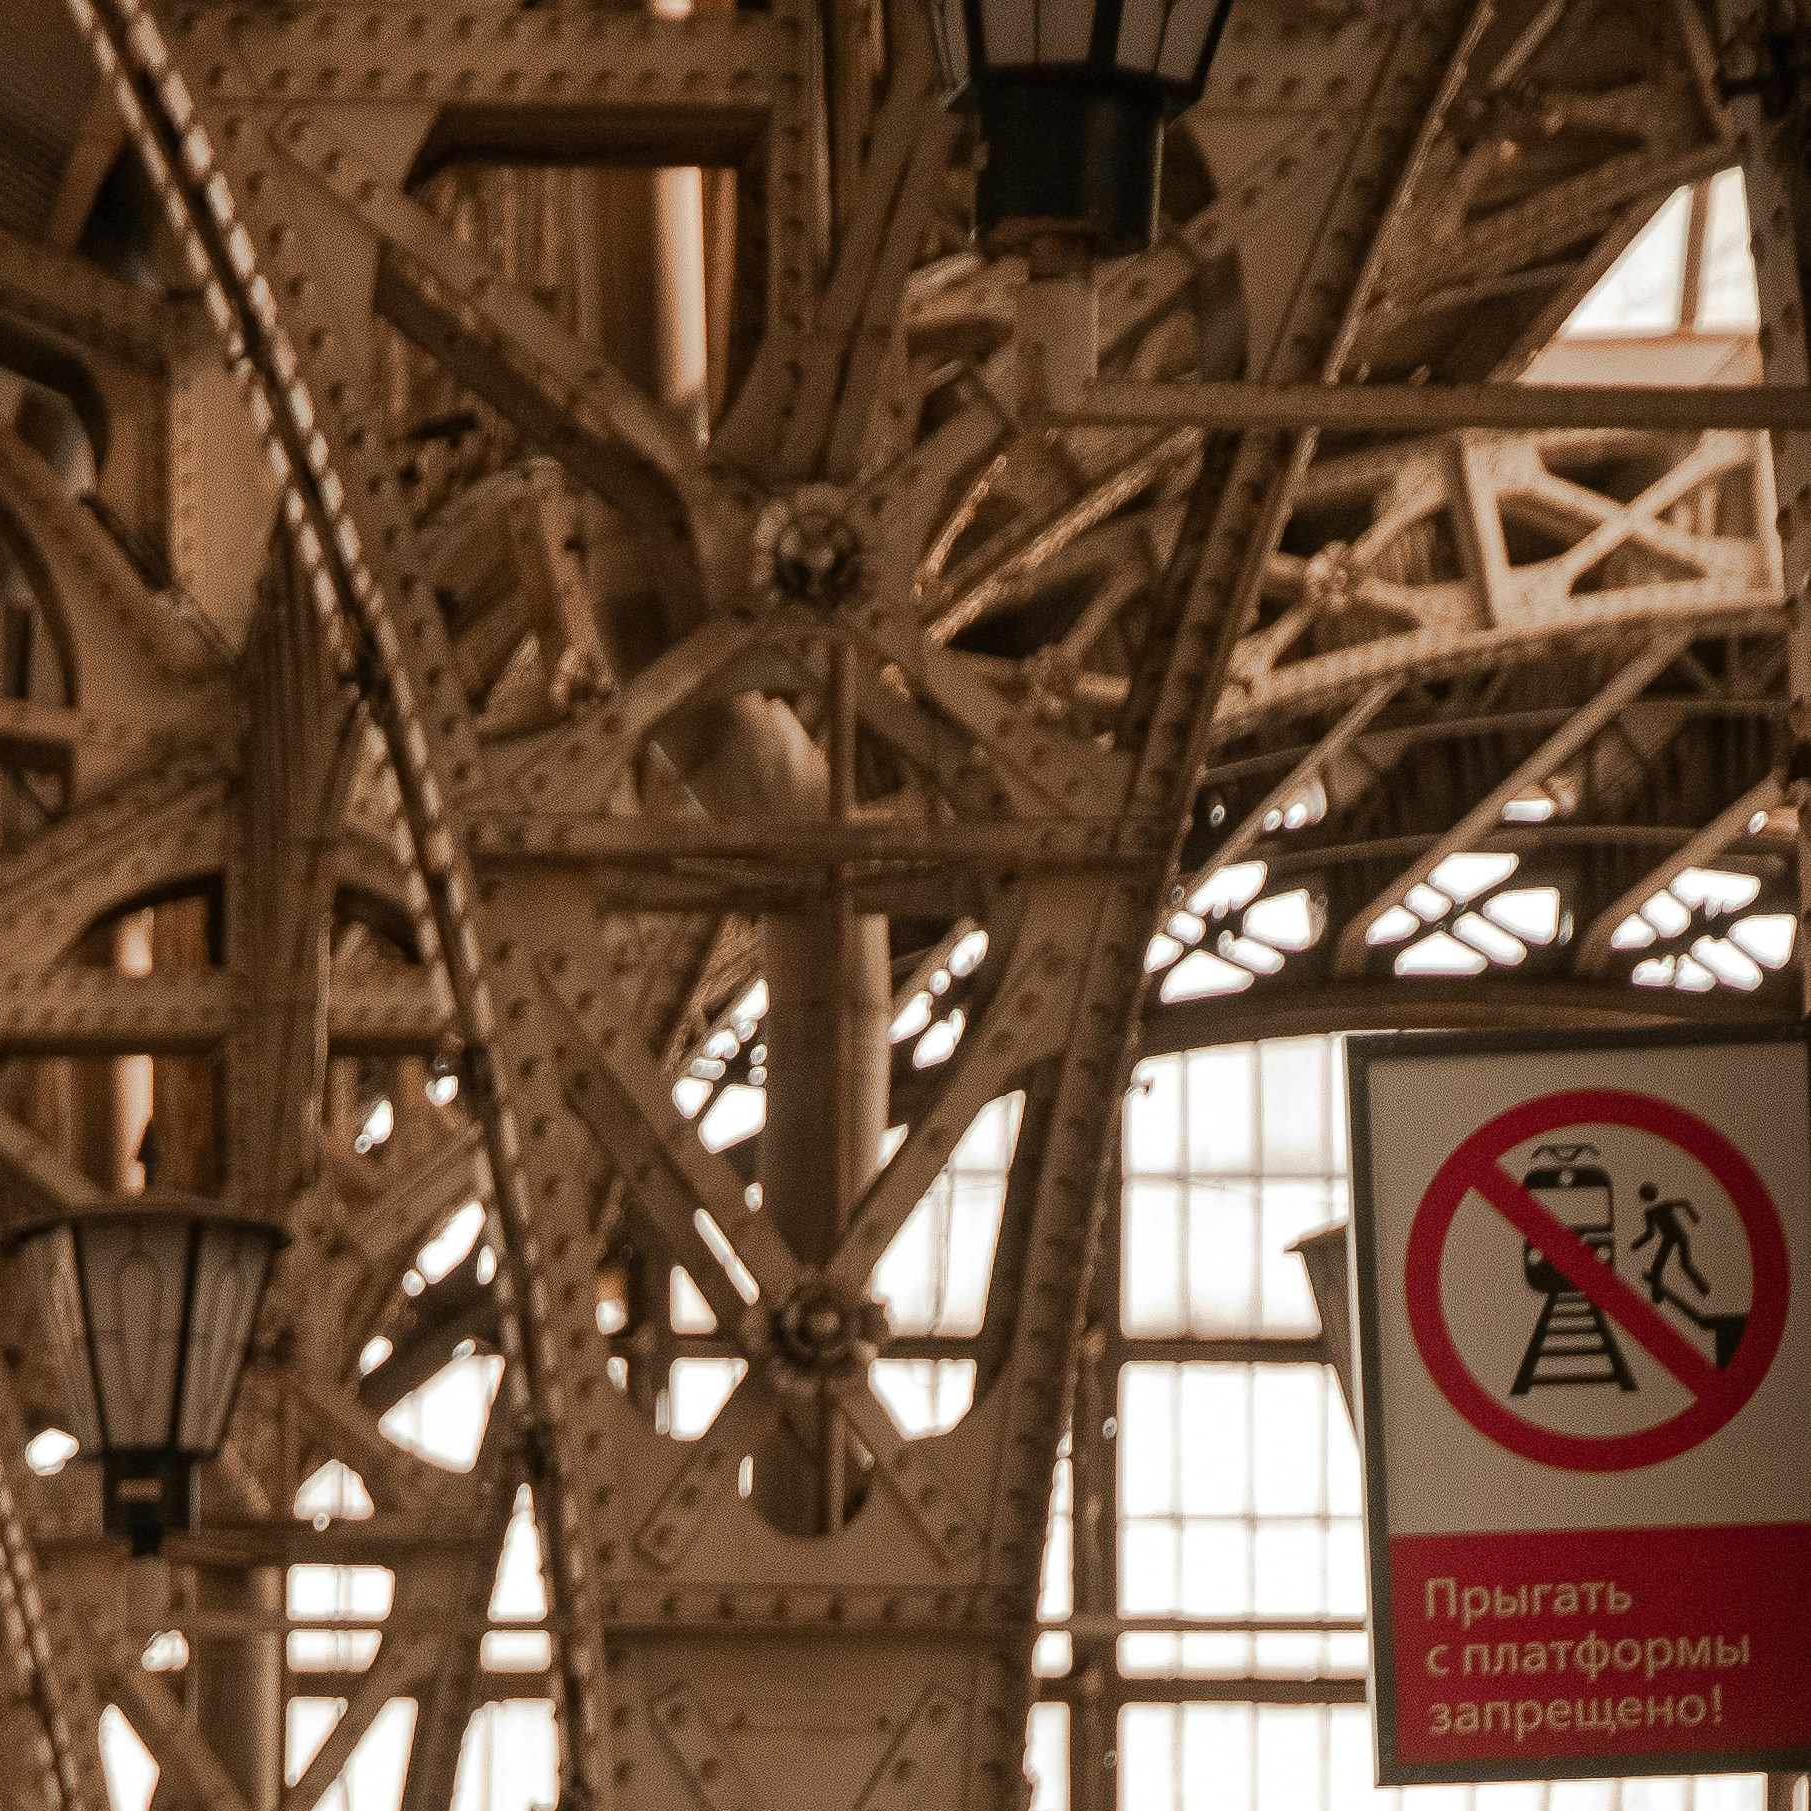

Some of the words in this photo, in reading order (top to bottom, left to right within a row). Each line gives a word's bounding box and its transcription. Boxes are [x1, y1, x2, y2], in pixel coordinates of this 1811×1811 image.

[1425, 1576, 1633, 1629] Прыгать
[1426, 1647, 1450, 1677] с
[1462, 1631, 1751, 1685] платформы
[1428, 1685, 1724, 1741] запрещено!
